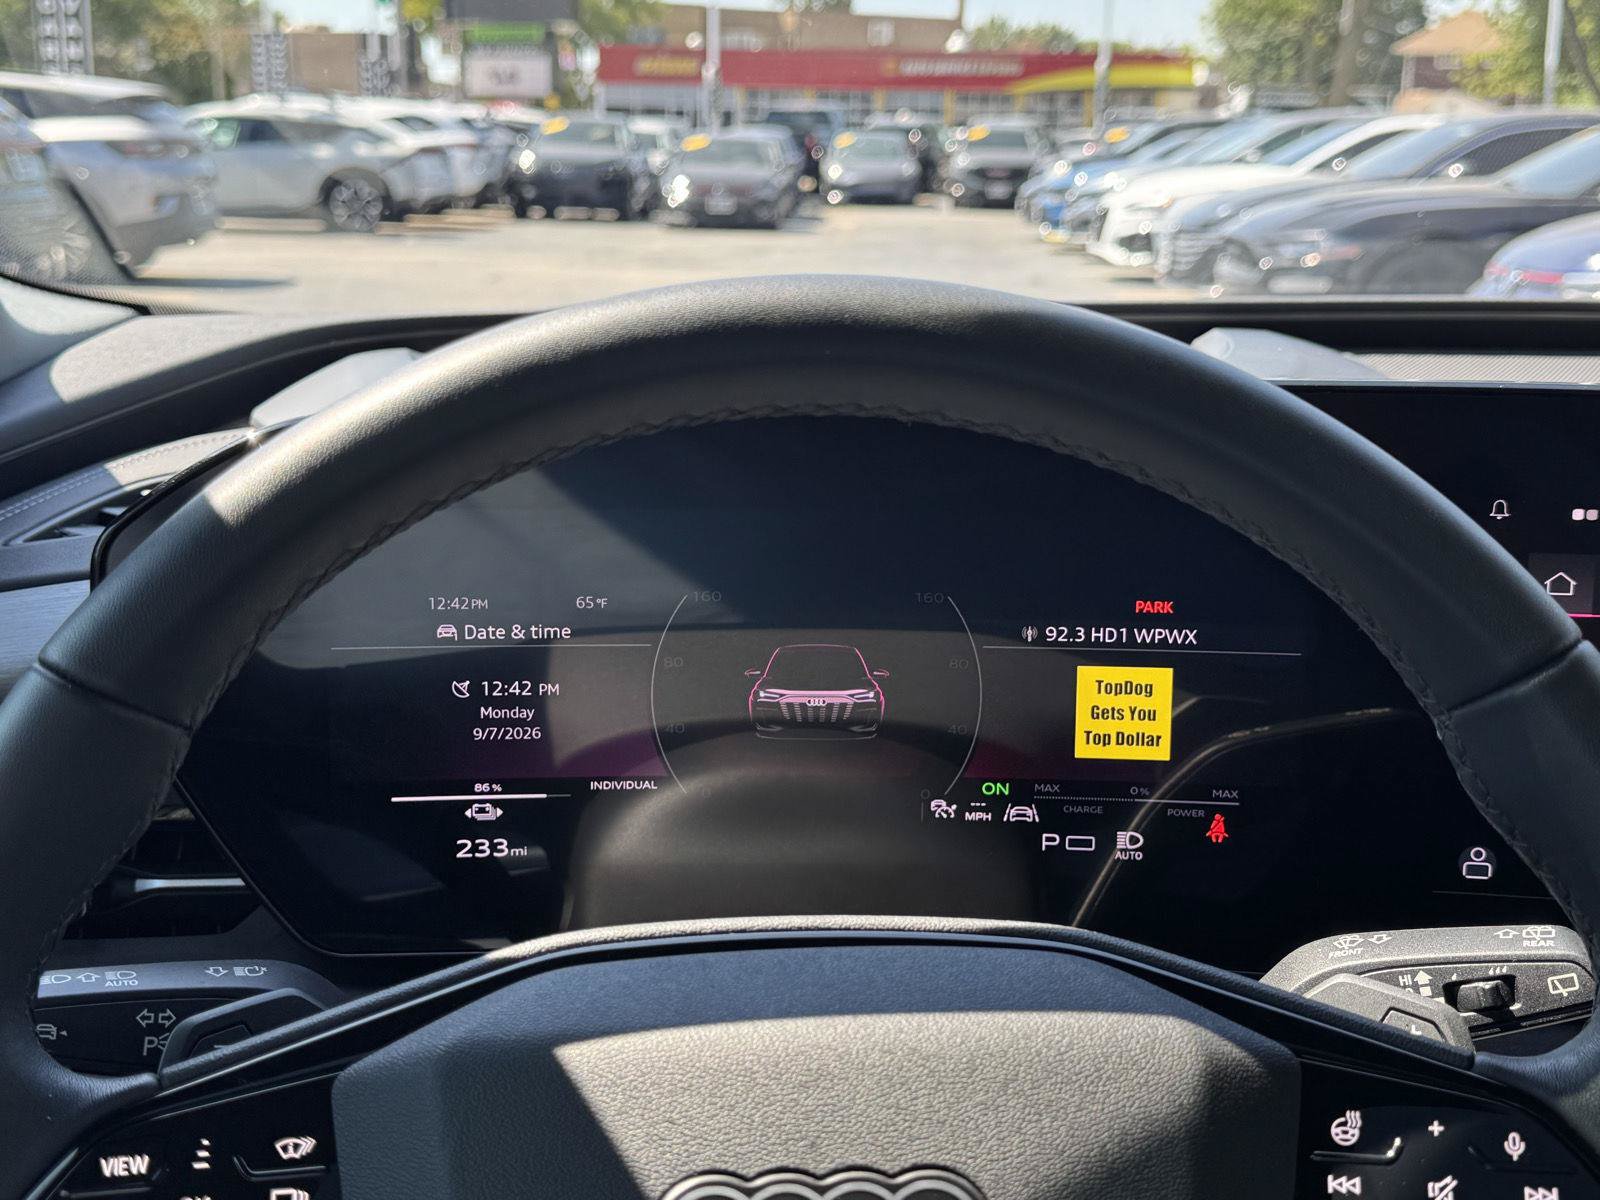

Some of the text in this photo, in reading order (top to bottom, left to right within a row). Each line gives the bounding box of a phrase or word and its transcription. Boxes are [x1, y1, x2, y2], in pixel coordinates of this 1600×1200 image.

[1135, 600, 1174, 614] PARK
[464, 624, 572, 640] Date & time
[1045, 626, 1198, 645] 92.3 HD1 WPWX
[481, 680, 560, 696] 12:42 PM
[1095, 679, 1154, 698] TopDog
[480, 706, 535, 721] Monday
[1090, 704, 1157, 722] Gets You
[473, 726, 541, 741] 9/7/2026
[1084, 730, 1162, 748] Top Dollar
[590, 780, 658, 791] INDIVIDUAL
[981, 782, 1010, 796] ON
[1034, 783, 1060, 793] MAX
[1212, 789, 1239, 799] MAX
[1063, 804, 1103, 814] CHARGE
[1167, 808, 1205, 818] POWER
[964, 812, 992, 822] MPH
[1041, 833, 1061, 851] P
[1114, 851, 1143, 861] AUTO
[1328, 948, 1363, 960] FRONT
[104, 980, 139, 988] AUTO
[1398, 974, 1413, 987] HI
[100, 1153, 150, 1178] VIEW
